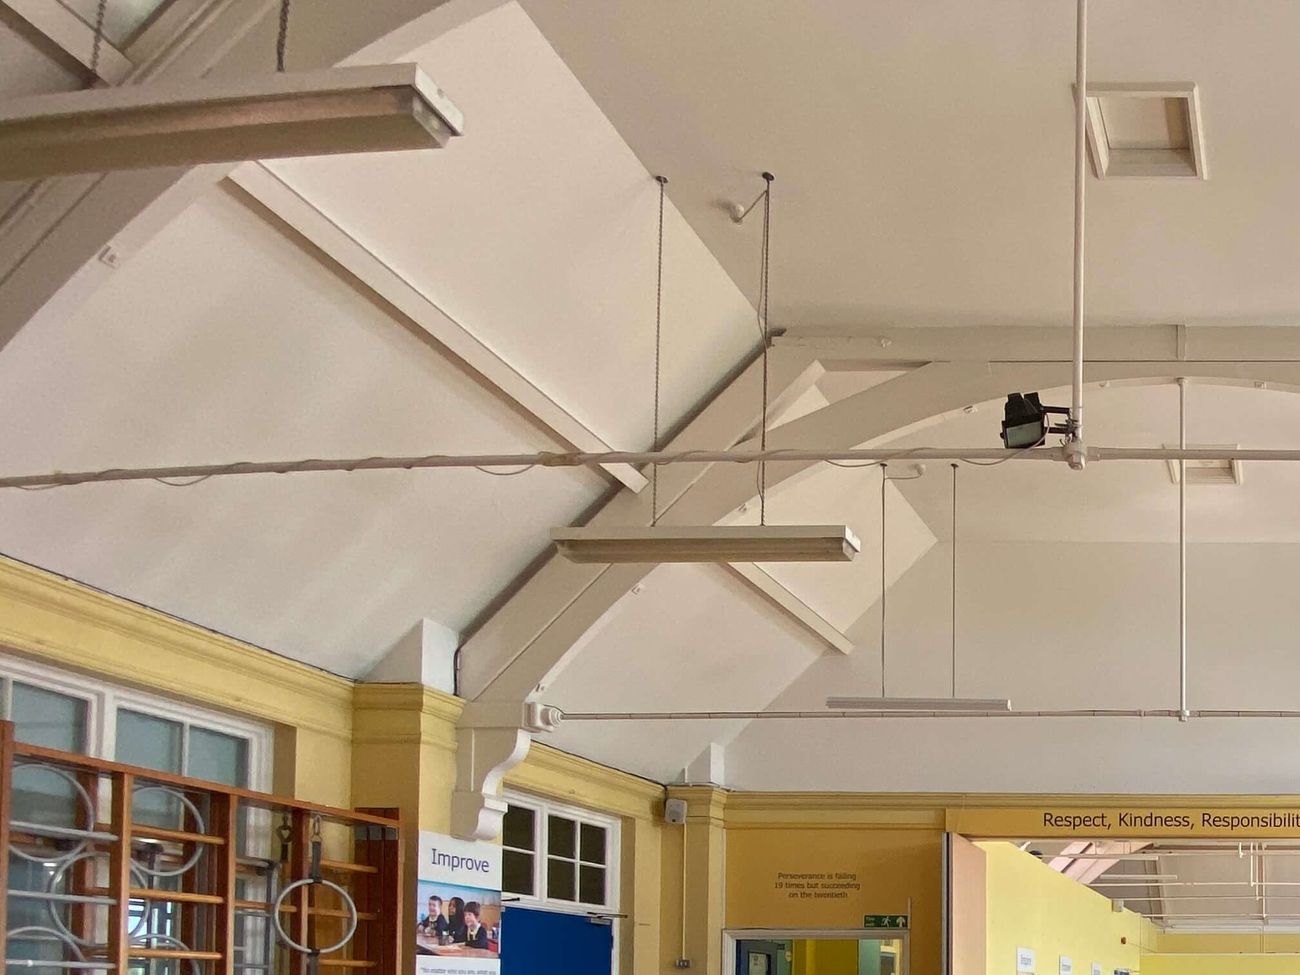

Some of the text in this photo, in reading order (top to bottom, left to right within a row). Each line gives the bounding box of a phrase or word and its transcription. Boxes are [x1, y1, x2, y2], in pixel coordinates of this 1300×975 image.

[1043, 812, 1112, 831] Respect,
[1118, 811, 1195, 831] Kindness,
[431, 848, 490, 873] Improve
[774, 881, 783, 889] 19
